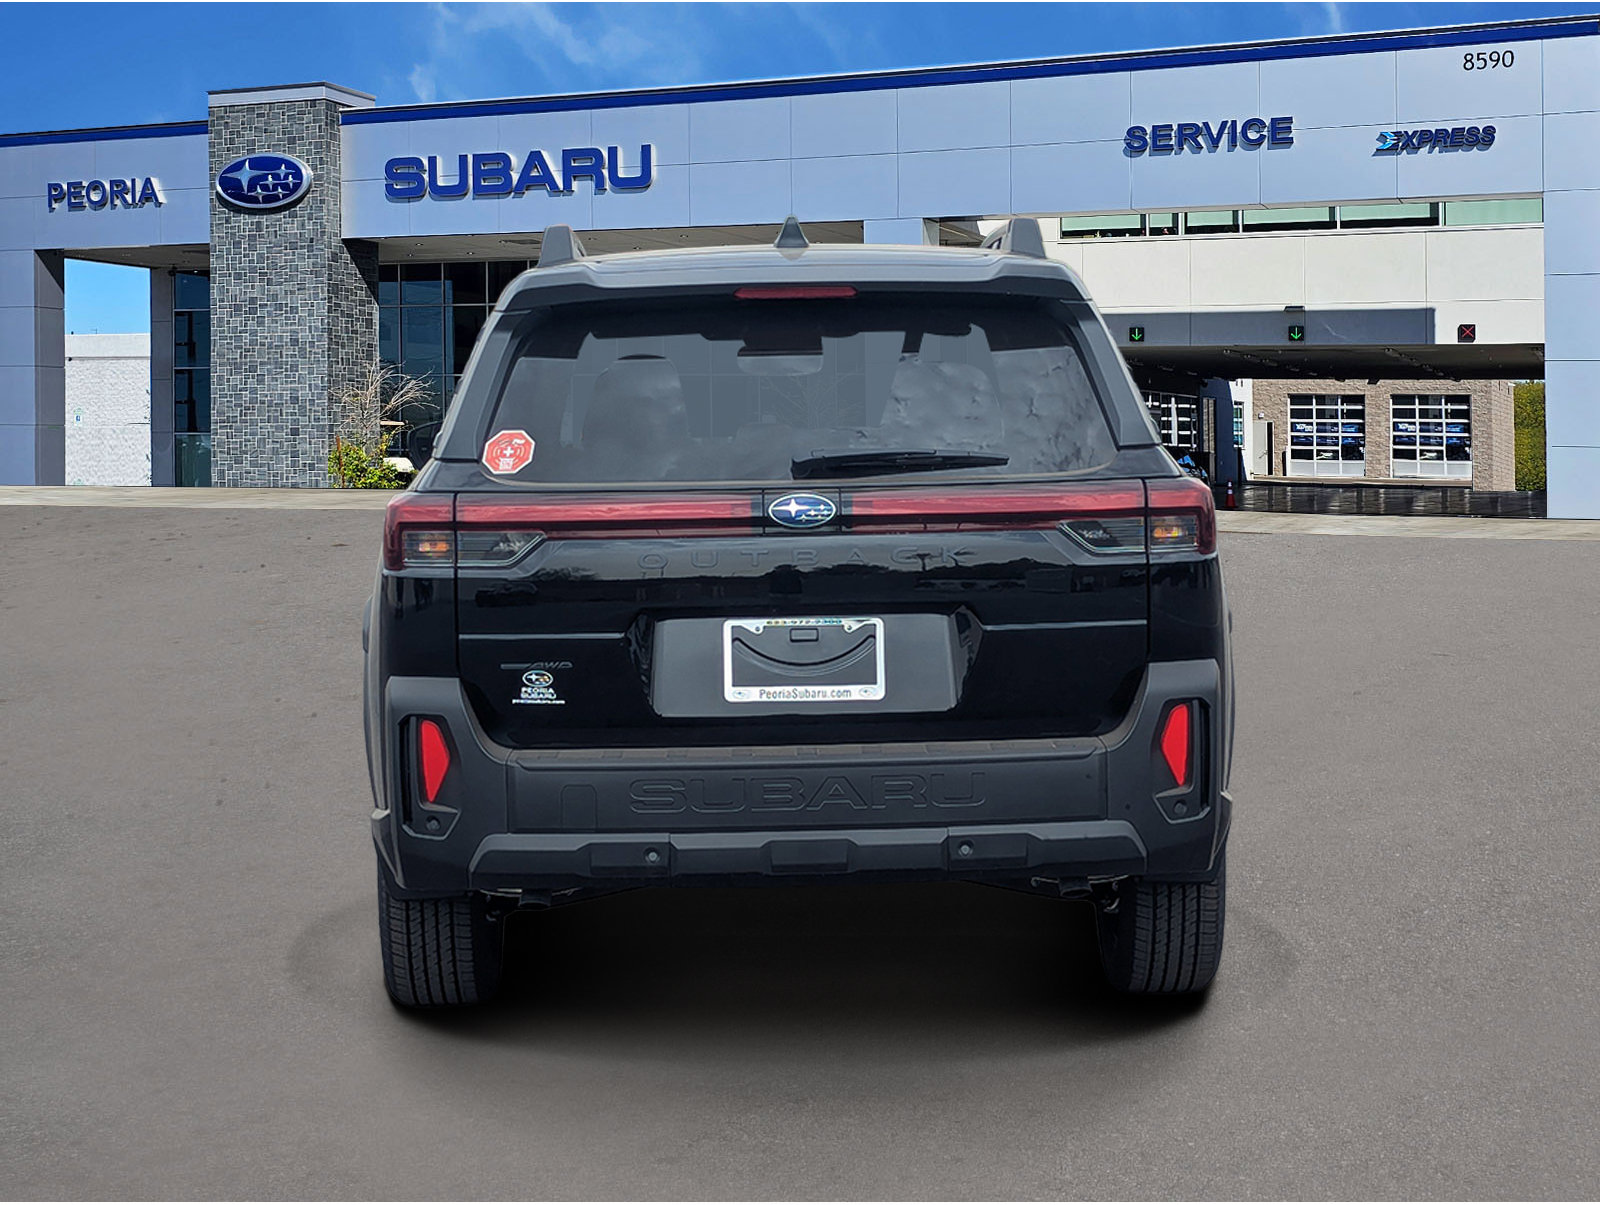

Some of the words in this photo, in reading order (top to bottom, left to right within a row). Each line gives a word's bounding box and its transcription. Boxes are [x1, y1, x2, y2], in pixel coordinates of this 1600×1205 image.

[1463, 50, 1515, 71] 8590
[1124, 116, 1293, 153] SERVICE
[384, 144, 652, 201] SUBARU
[47, 177, 162, 212] PEORIA
[637, 547, 967, 570] OUTBACK
[758, 687, 852, 699] PeoriaSubaru.com
[629, 772, 986, 814] SUBARU
